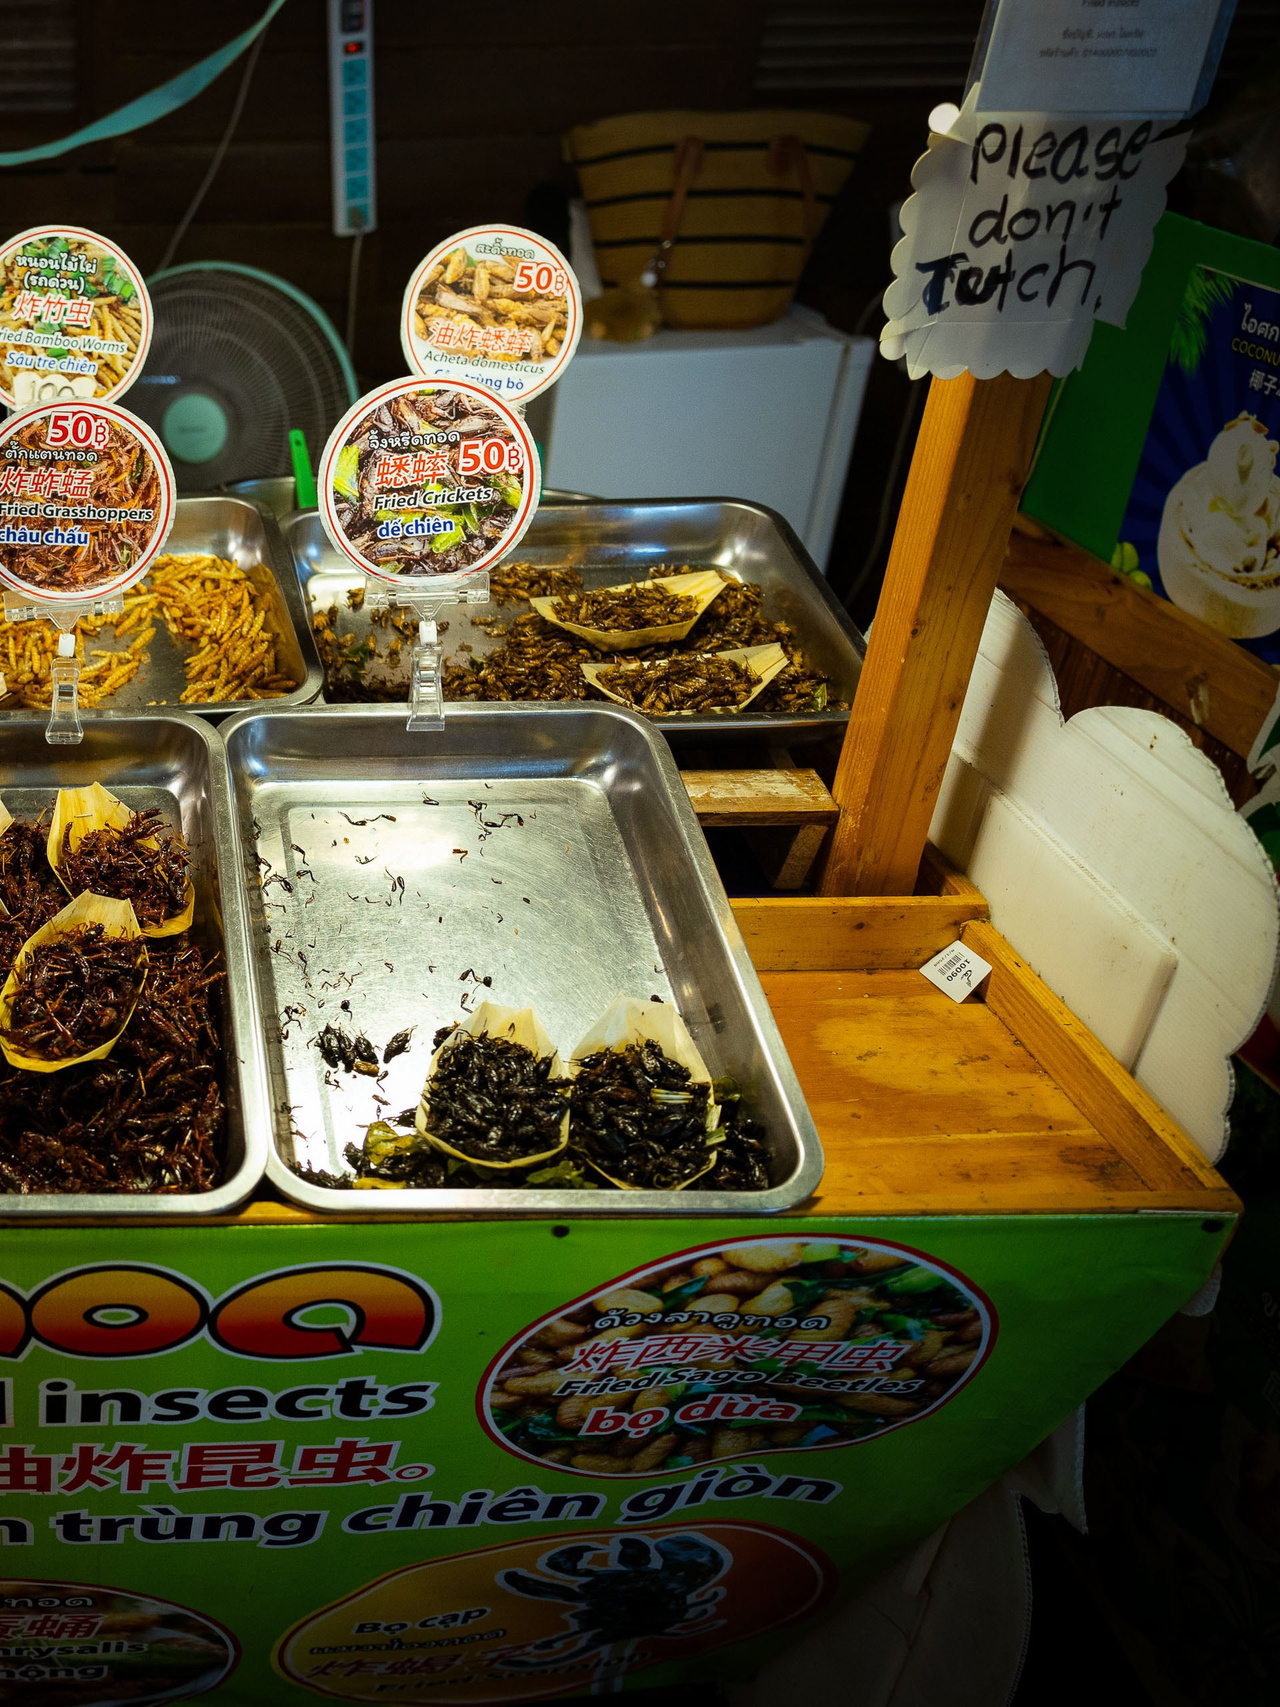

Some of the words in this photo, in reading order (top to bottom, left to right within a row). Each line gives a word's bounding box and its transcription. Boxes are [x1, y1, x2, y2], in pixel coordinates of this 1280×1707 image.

[968, 184, 1122, 248] don't
[16, 252, 97, 274] หนอนไม้ไผ่
[23, 271, 84, 294] (รถด่วน)
[13, 293, 93, 327] 炸竹虫
[25, 332, 79, 349] Bamboo
[82, 338, 126, 354] Worms
[429, 321, 533, 355] 油炸蟋蟀
[7, 352, 35, 367] Sâu
[37, 358, 56, 370] tre
[59, 358, 97, 373] chiên
[424, 350, 468, 366] Acheta
[471, 356, 545, 375] domesticus
[506, 376, 524, 391] bò
[1248, 368, 1280, 396] 椰子
[5, 441, 98, 462] ตั๊กแตนทอด
[368, 430, 461, 451] จิ้งหรีดทอด
[375, 452, 447, 487] 蟋蟀
[374, 493, 419, 510] Fried
[422, 486, 492, 505] Crickets
[42, 504, 153, 523] Grasshoppers
[44, 526, 90, 545] chấu
[378, 515, 402, 538] dế
[405, 517, 454, 536] chiên
[946, 958, 971, 982] 10090
[593, 1308, 833, 1333] ด้วงสาคูทอด
[563, 1334, 911, 1373] 炸西米甲虫
[556, 1372, 661, 1396] Fried
[668, 1367, 767, 1389] Sago
[771, 1372, 923, 1395] Beetles
[43, 1378, 432, 1426] insects
[582, 1406, 672, 1438] bọ
[676, 1393, 802, 1424] dừa
[54, 1506, 322, 1546] trùng
[347, 1486, 601, 1530] chiên
[620, 1465, 837, 1523] giòn
[355, 1622, 408, 1636] Bọ
[418, 1607, 488, 1629] cạp
